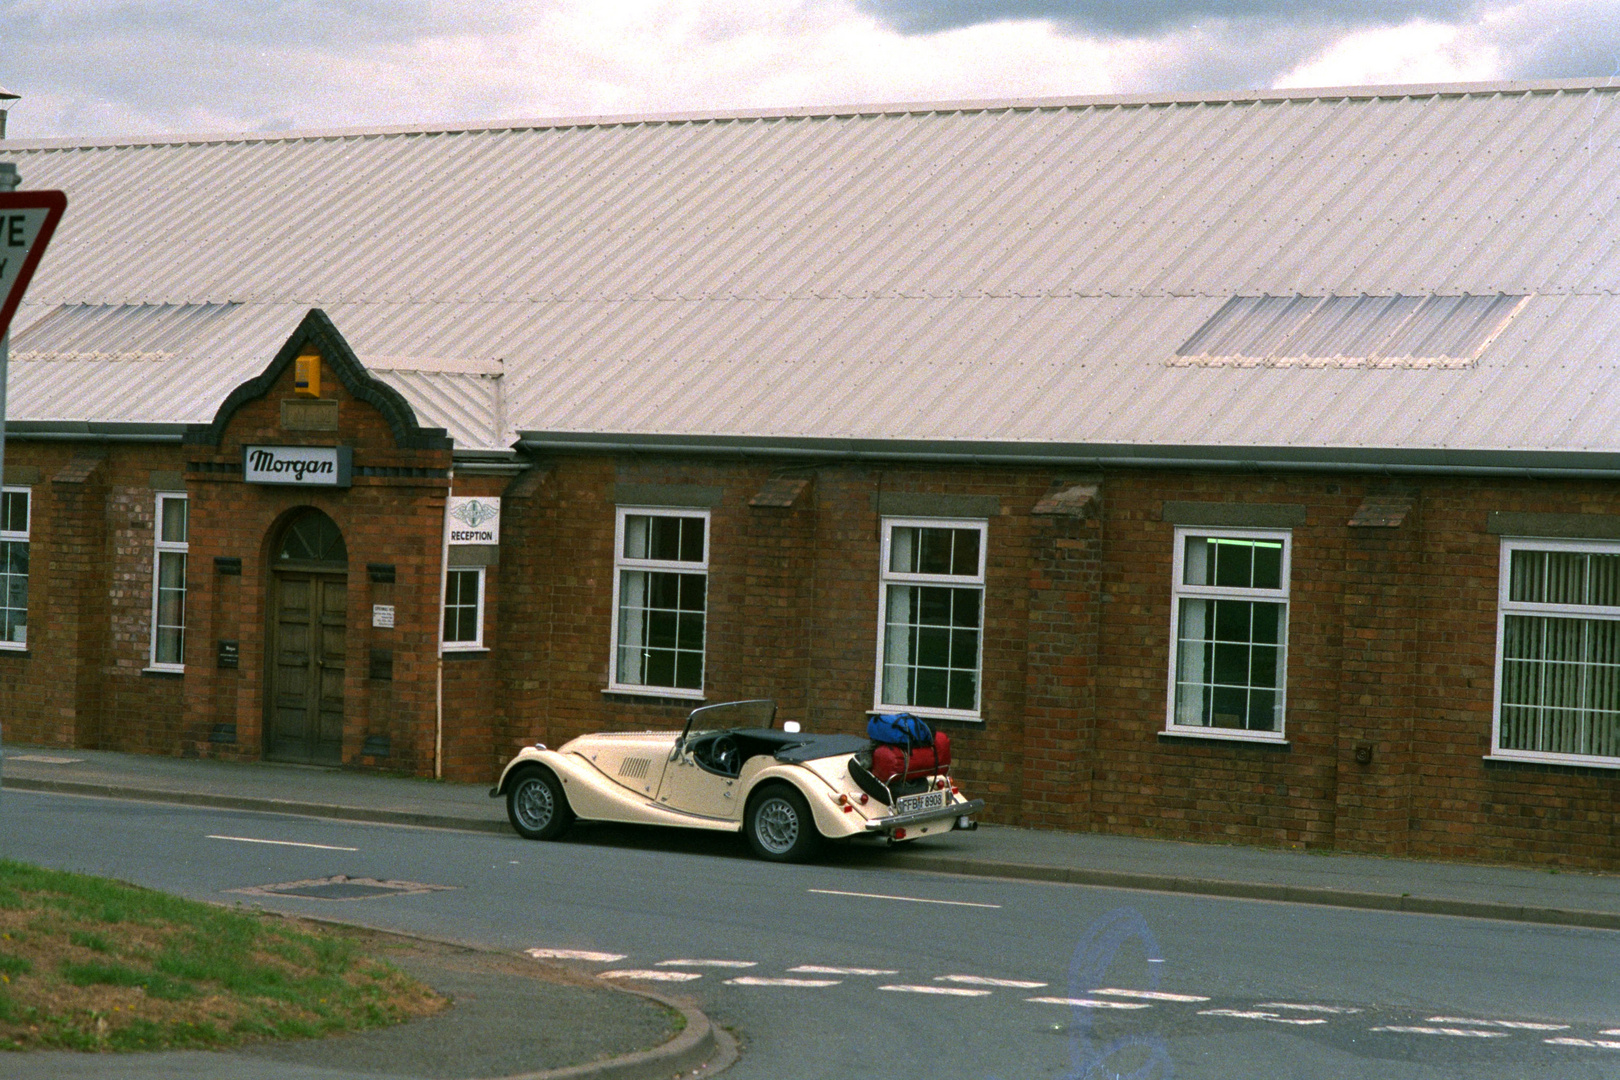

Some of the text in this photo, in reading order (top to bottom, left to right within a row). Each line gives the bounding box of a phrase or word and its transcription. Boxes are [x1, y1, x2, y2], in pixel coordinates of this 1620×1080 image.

[0, 215, 26, 247] E
[249, 450, 333, 481] Morgan
[451, 531, 493, 541] RECEPTION
